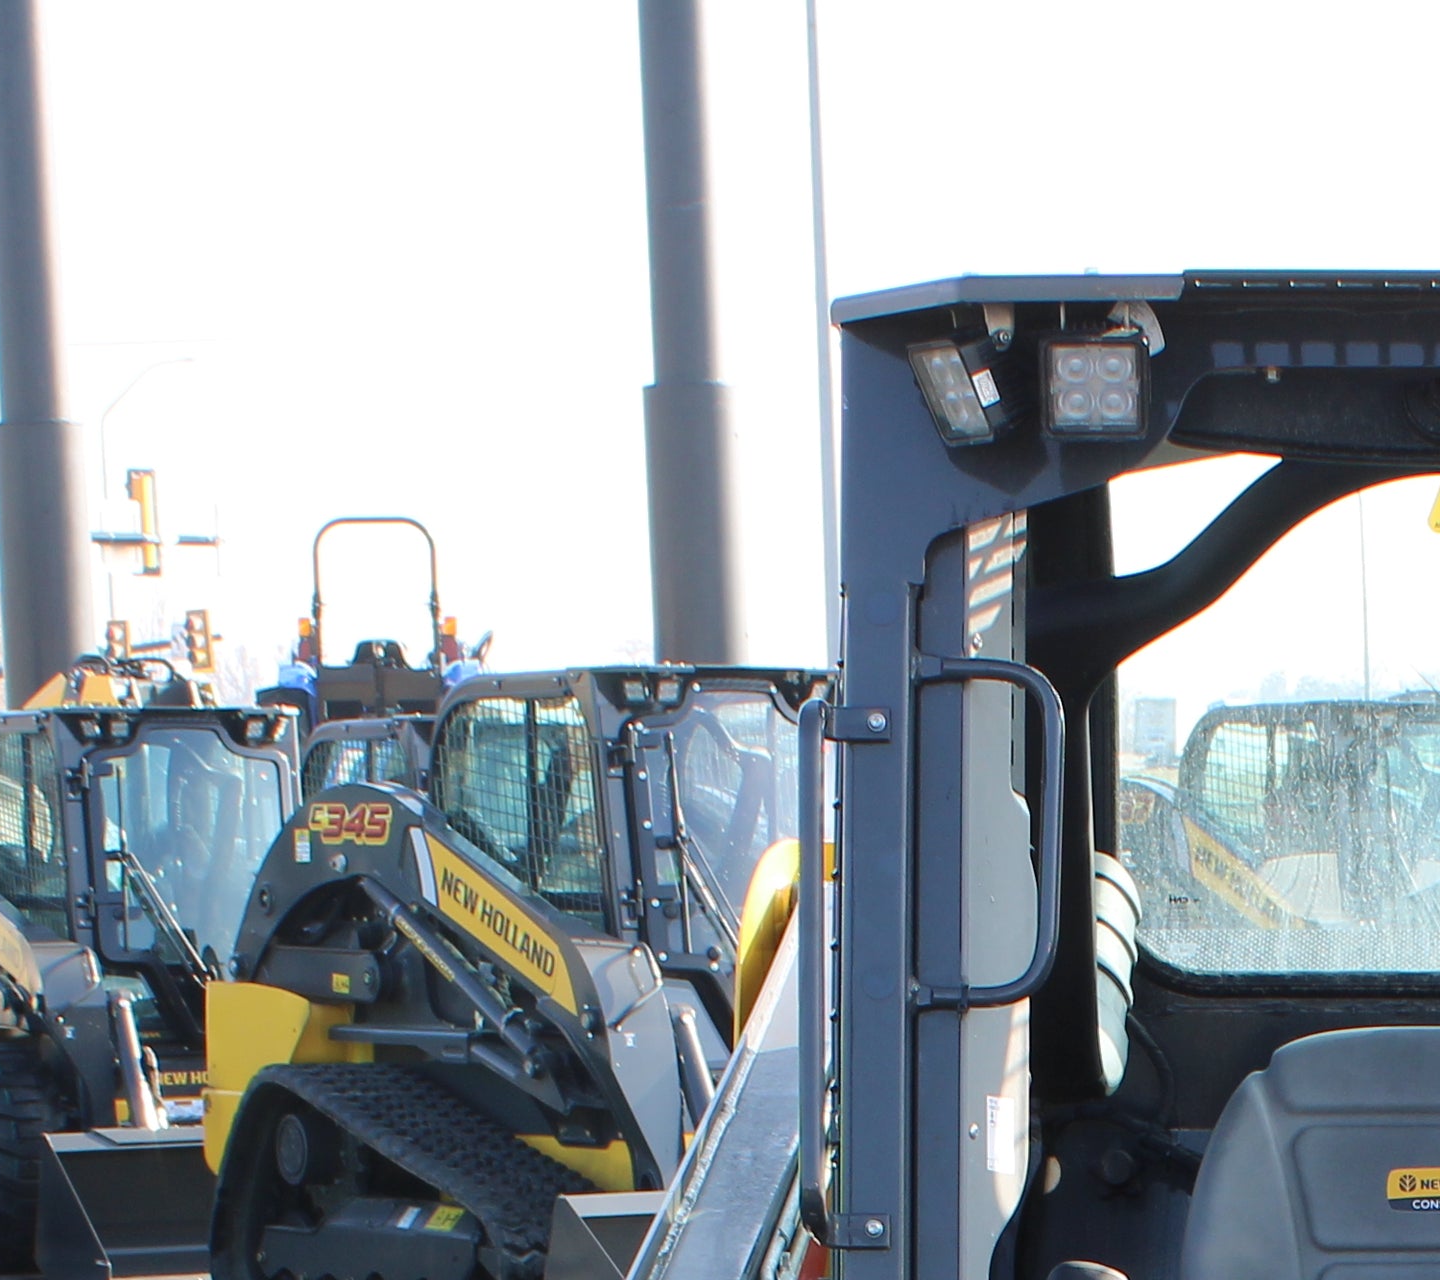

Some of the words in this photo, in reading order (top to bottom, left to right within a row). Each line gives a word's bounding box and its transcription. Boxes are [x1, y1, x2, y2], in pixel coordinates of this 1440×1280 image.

[309, 803, 393, 846] C345
[441, 867, 478, 915] NEW
[480, 897, 555, 977] HOLLAND
